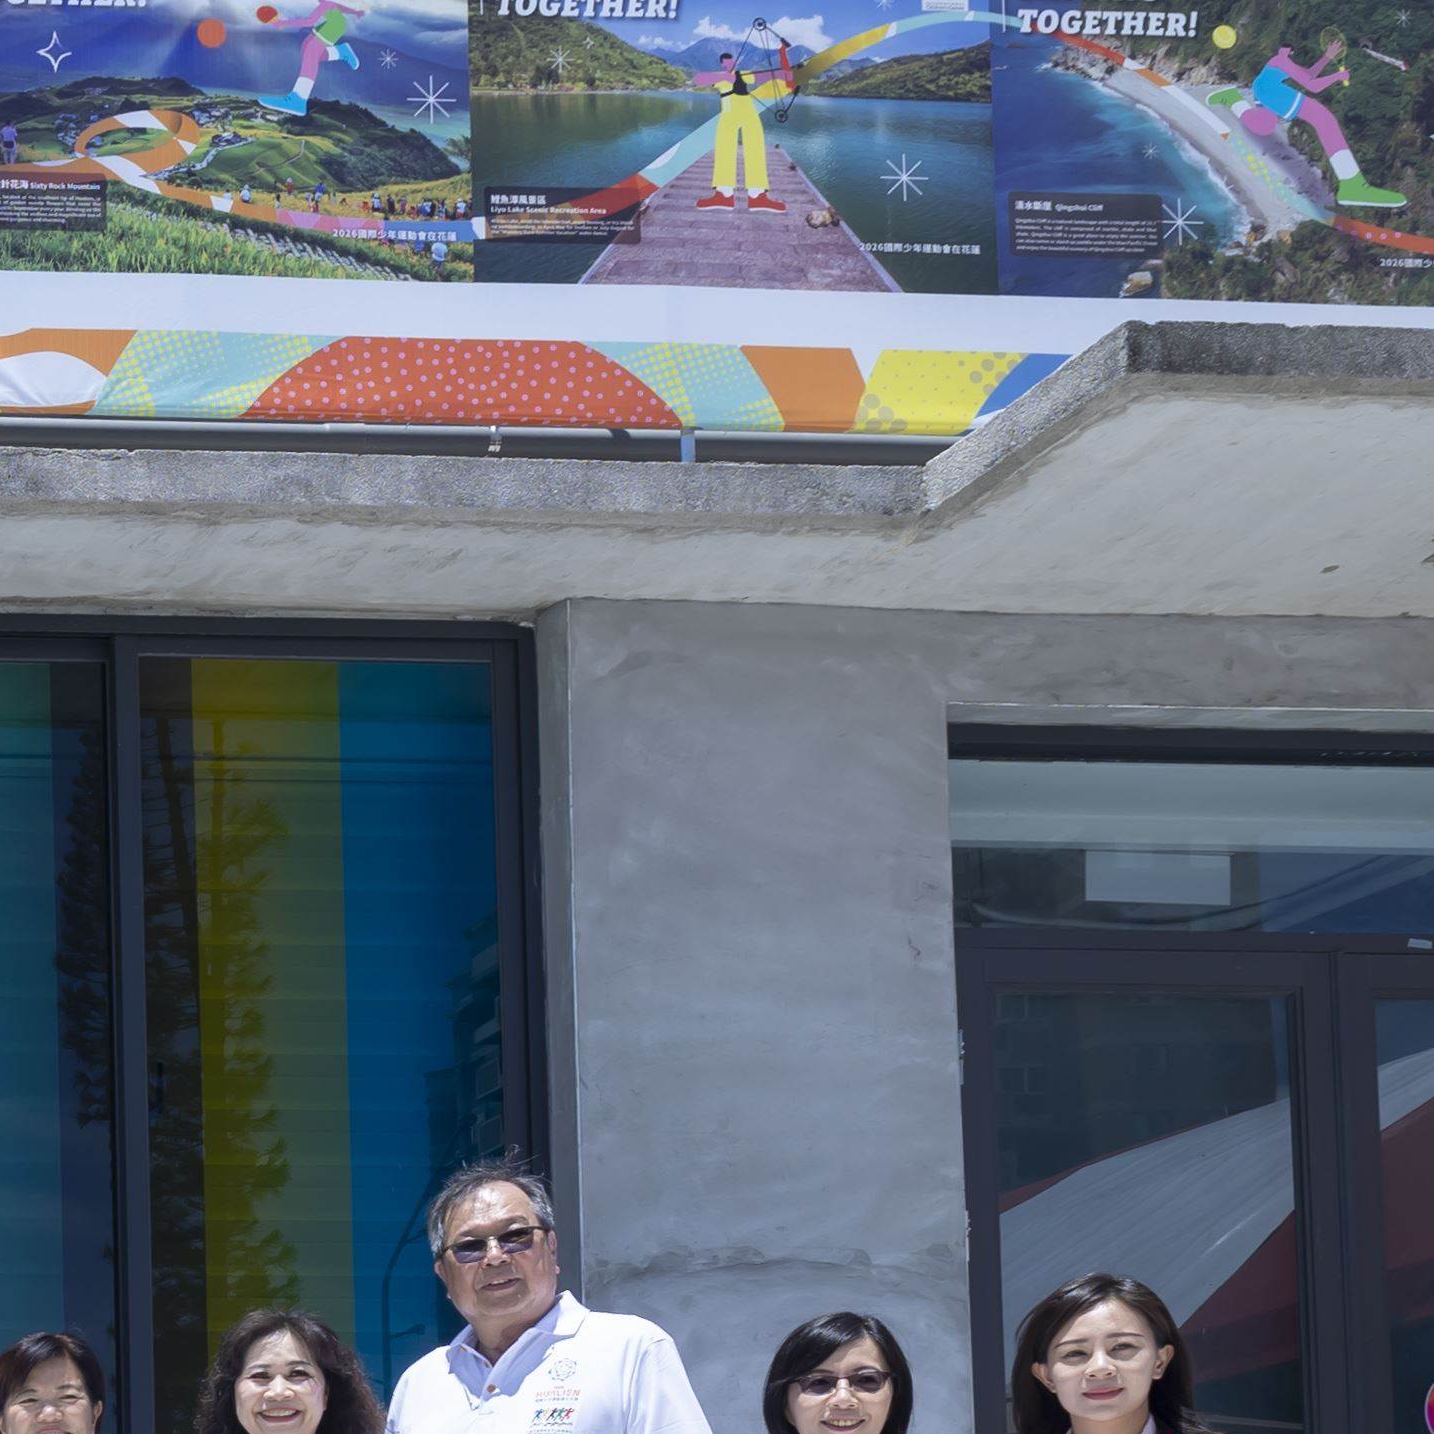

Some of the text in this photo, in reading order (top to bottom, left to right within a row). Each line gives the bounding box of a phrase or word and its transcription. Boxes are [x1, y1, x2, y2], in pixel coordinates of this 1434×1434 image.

[1017, 8, 1198, 38] TOGETHER!
[48, 182, 66, 190] Rock
[67, 182, 101, 190] Mountain
